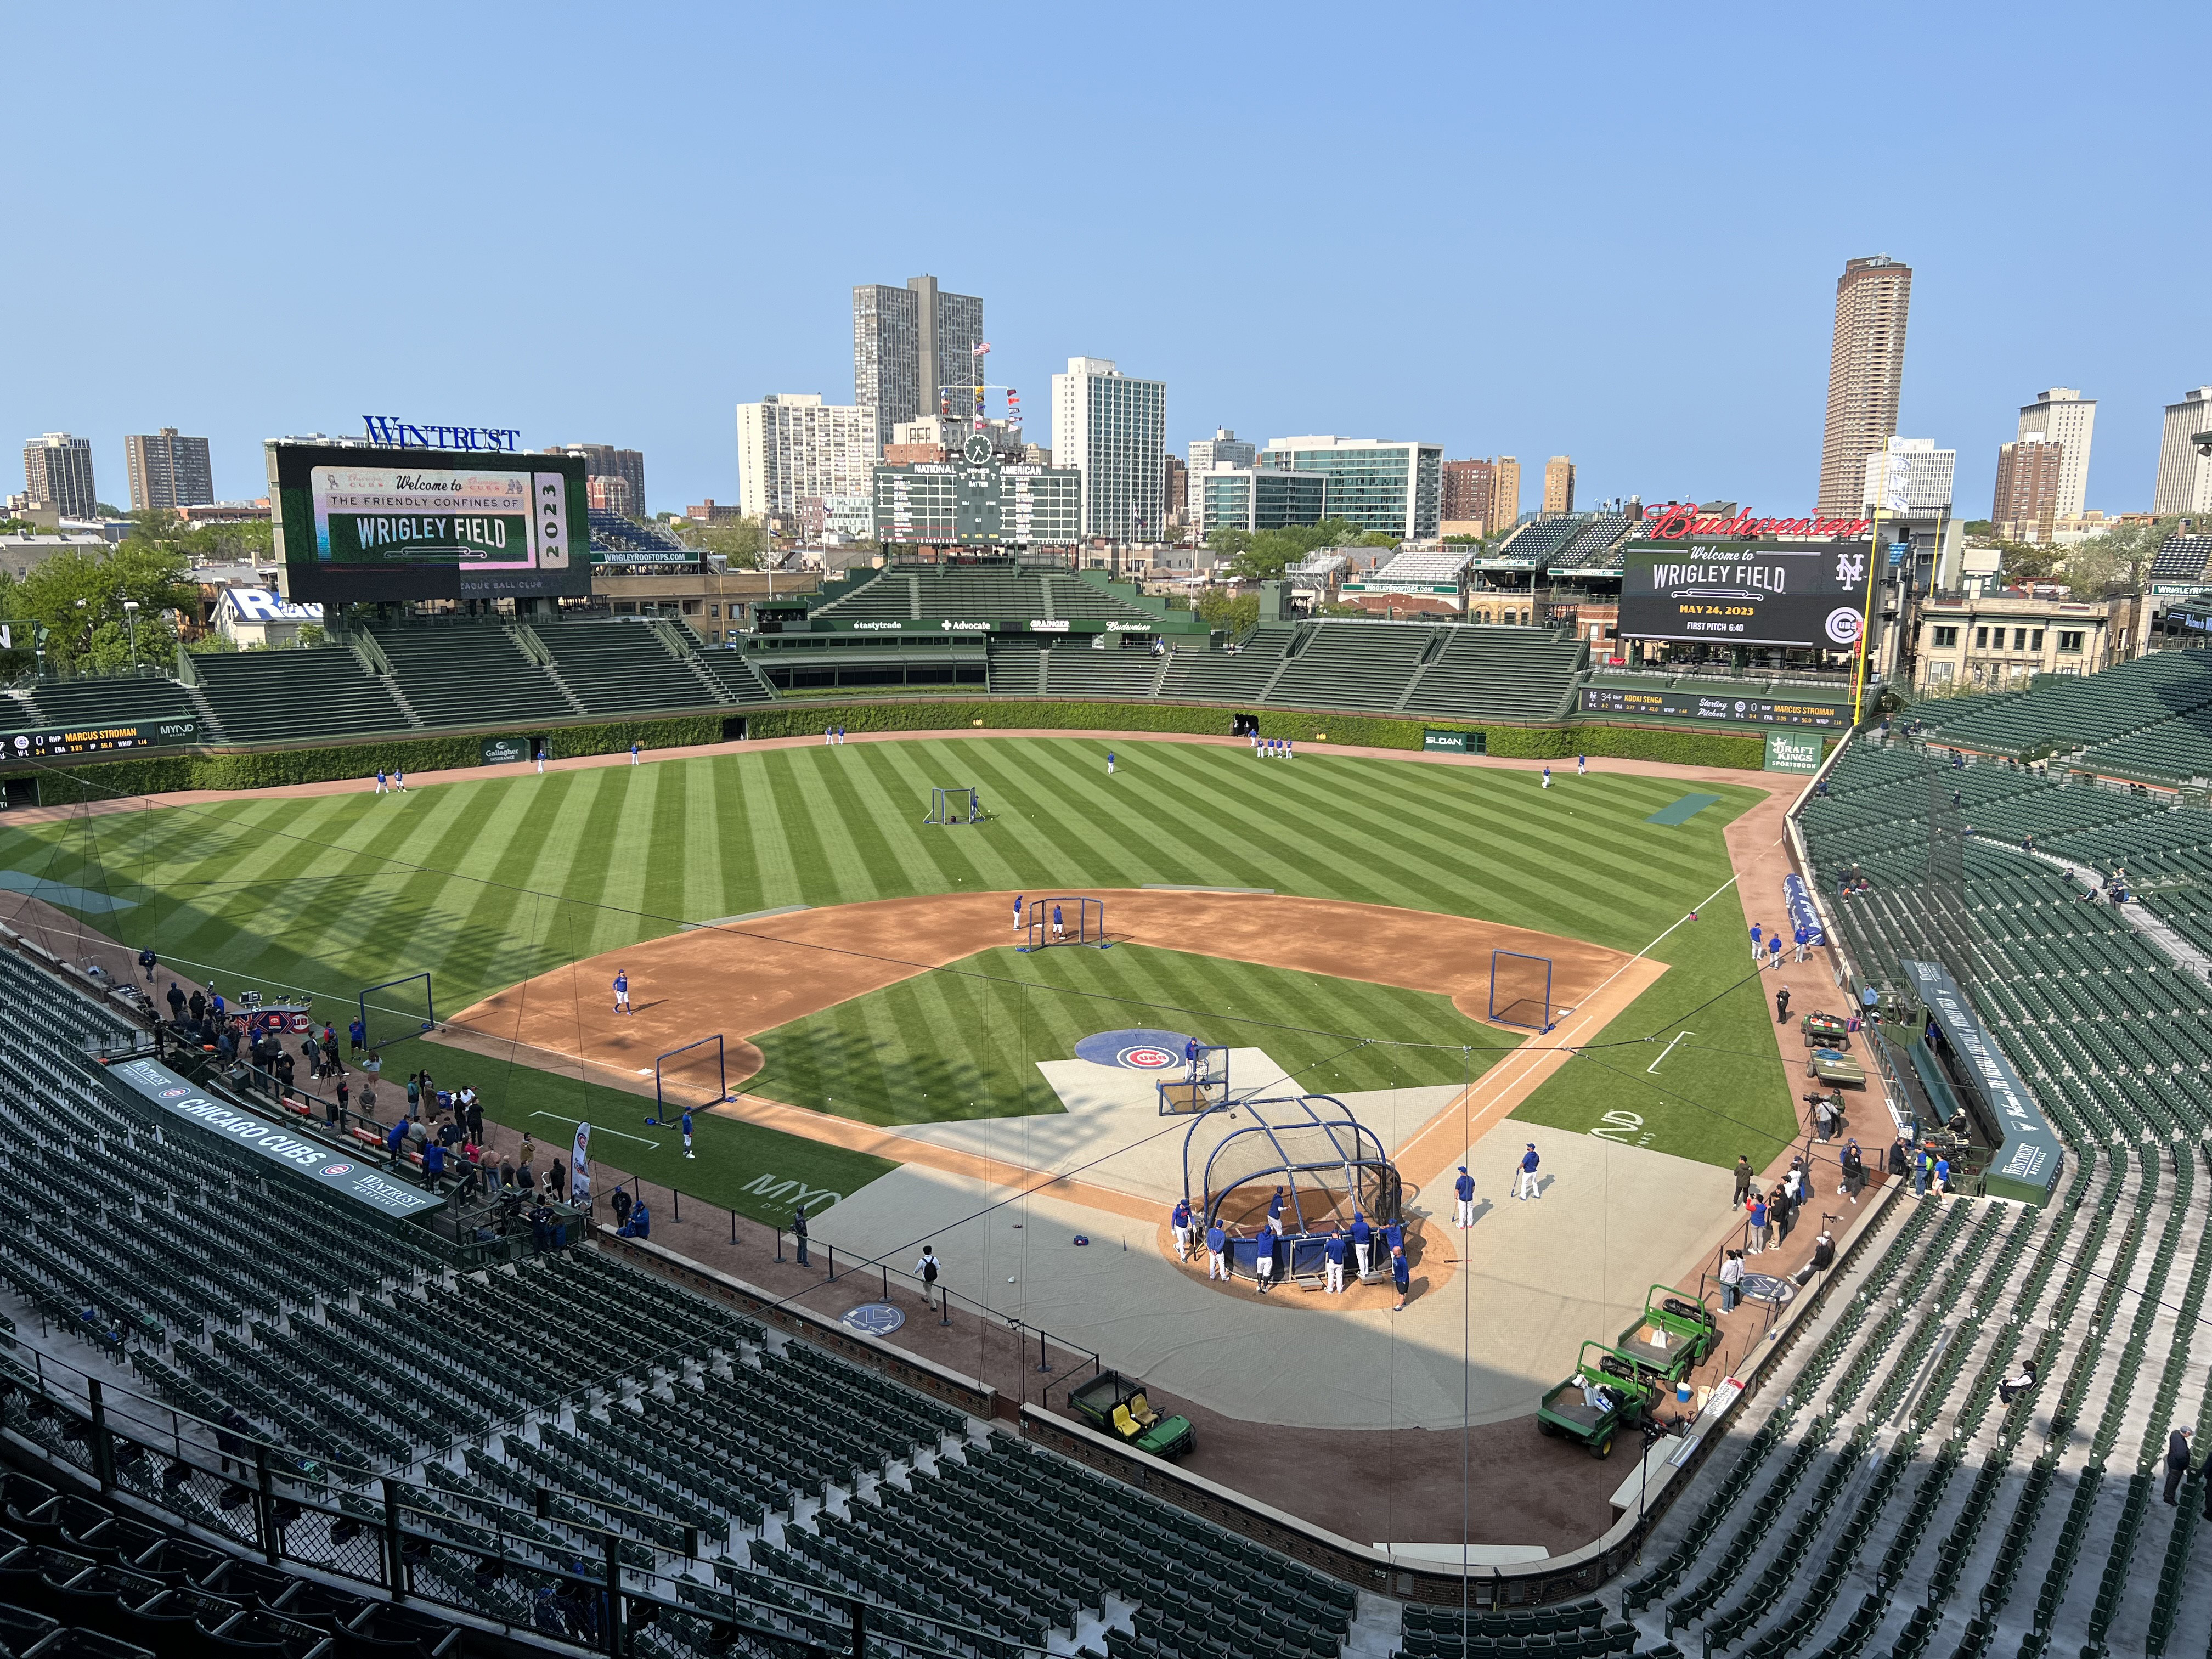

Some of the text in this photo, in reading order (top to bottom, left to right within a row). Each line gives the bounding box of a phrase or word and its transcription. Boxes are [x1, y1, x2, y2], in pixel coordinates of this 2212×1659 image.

[915, 465, 956, 473] NATIONAL
[1000, 466, 1041, 475] AMERICAN
[396, 475, 462, 491] Welcome to
[331, 496, 518, 507] THE FRIENDLY CONFINES OF
[542, 484, 560, 558] 2023
[1643, 503, 1871, 539] Budweiser
[357, 517, 505, 550] WRIGLEY FIELD
[604, 553, 685, 562] WRIGLEYROOFTOPS.COM
[1690, 545, 1754, 561] Welcome to
[1654, 564, 1785, 593] WRIGLEY FIELD
[1679, 605, 1754, 616] MAY 24, 2023
[859, 621, 901, 630] tastytrade
[953, 621, 990, 630] Advocate
[1106, 622, 1151, 631] Budweiser
[1687, 622, 1706, 630] FIRST
[1707, 623, 1726, 631] PITCH
[1600, 693, 1611, 701] 34
[1643, 696, 1662, 704] SENGA
[1699, 698, 1728, 710] Starting
[1697, 708, 1727, 718] Pitchers
[1751, 703, 1757, 712] 0
[1774, 704, 1801, 714] MARCUS
[1802, 706, 1835, 716] STROMAN
[160, 724, 194, 735] MYND
[36, 735, 43, 746] 0
[65, 731, 98, 742] MARCUS
[99, 727, 137, 740] STROMAN
[1426, 737, 1461, 745] SLOAN
[486, 748, 519, 757] Gallagher
[1773, 745, 1815, 754] DRAFT
[1778, 753, 1813, 762] KINGS
[131, 1060, 172, 1085] WINTRUST
[177, 1098, 269, 1138] CHICAGO
[258, 1135, 328, 1165] CUBS
[1591, 1110, 1644, 1142] ND
[2002, 1142, 2035, 1175] WINTRUST
[358, 1174, 426, 1206] WINTRUST
[352, 1186, 398, 1207] MORTGAGE
[844, 1316, 885, 1334] TRAFFIC TECH
